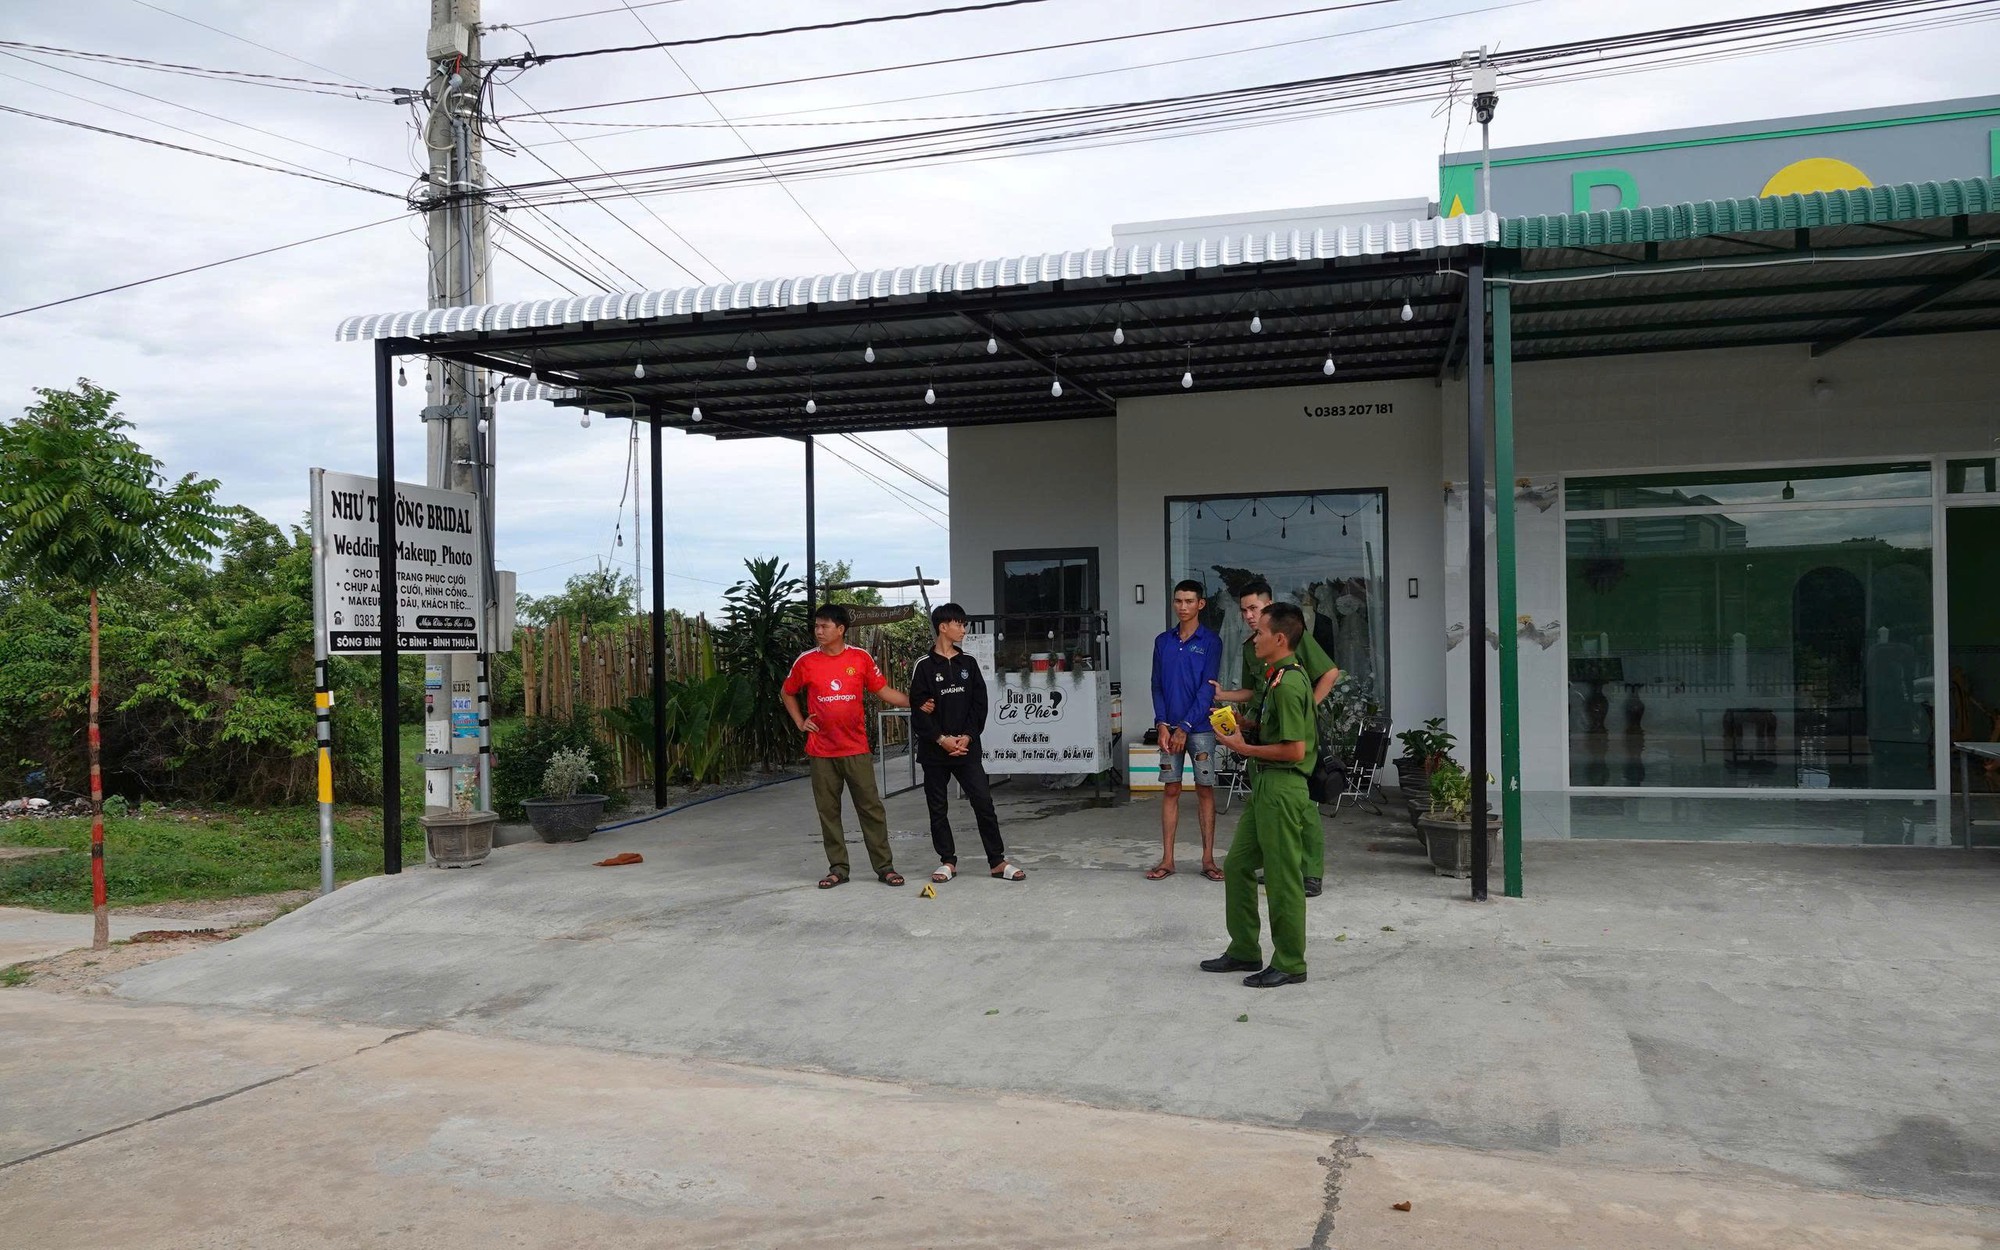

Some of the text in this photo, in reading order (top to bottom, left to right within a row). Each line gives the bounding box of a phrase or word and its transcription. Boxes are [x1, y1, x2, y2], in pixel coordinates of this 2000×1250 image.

[1314, 403, 1393, 417] 0383 207 181
[331, 489, 472, 534] NHƯ TỜNG BRIDAL
[334, 534, 380, 558] Weddin
[353, 568, 373, 579] CHO
[396, 572, 423, 582] TRANG
[425, 574, 446, 585] PHỤC
[344, 582, 368, 594] CHỤP
[425, 584, 443, 596] HÌNH
[421, 598, 448, 609] KHÁCH
[336, 635, 362, 647] SÔNG
[409, 635, 427, 647] BÌNH
[433, 636, 451, 647] BÌNH
[452, 636, 475, 649] THUẬN
[817, 694, 856, 702] Snapdragon
[1013, 734, 1049, 743] Coffee & Tea
